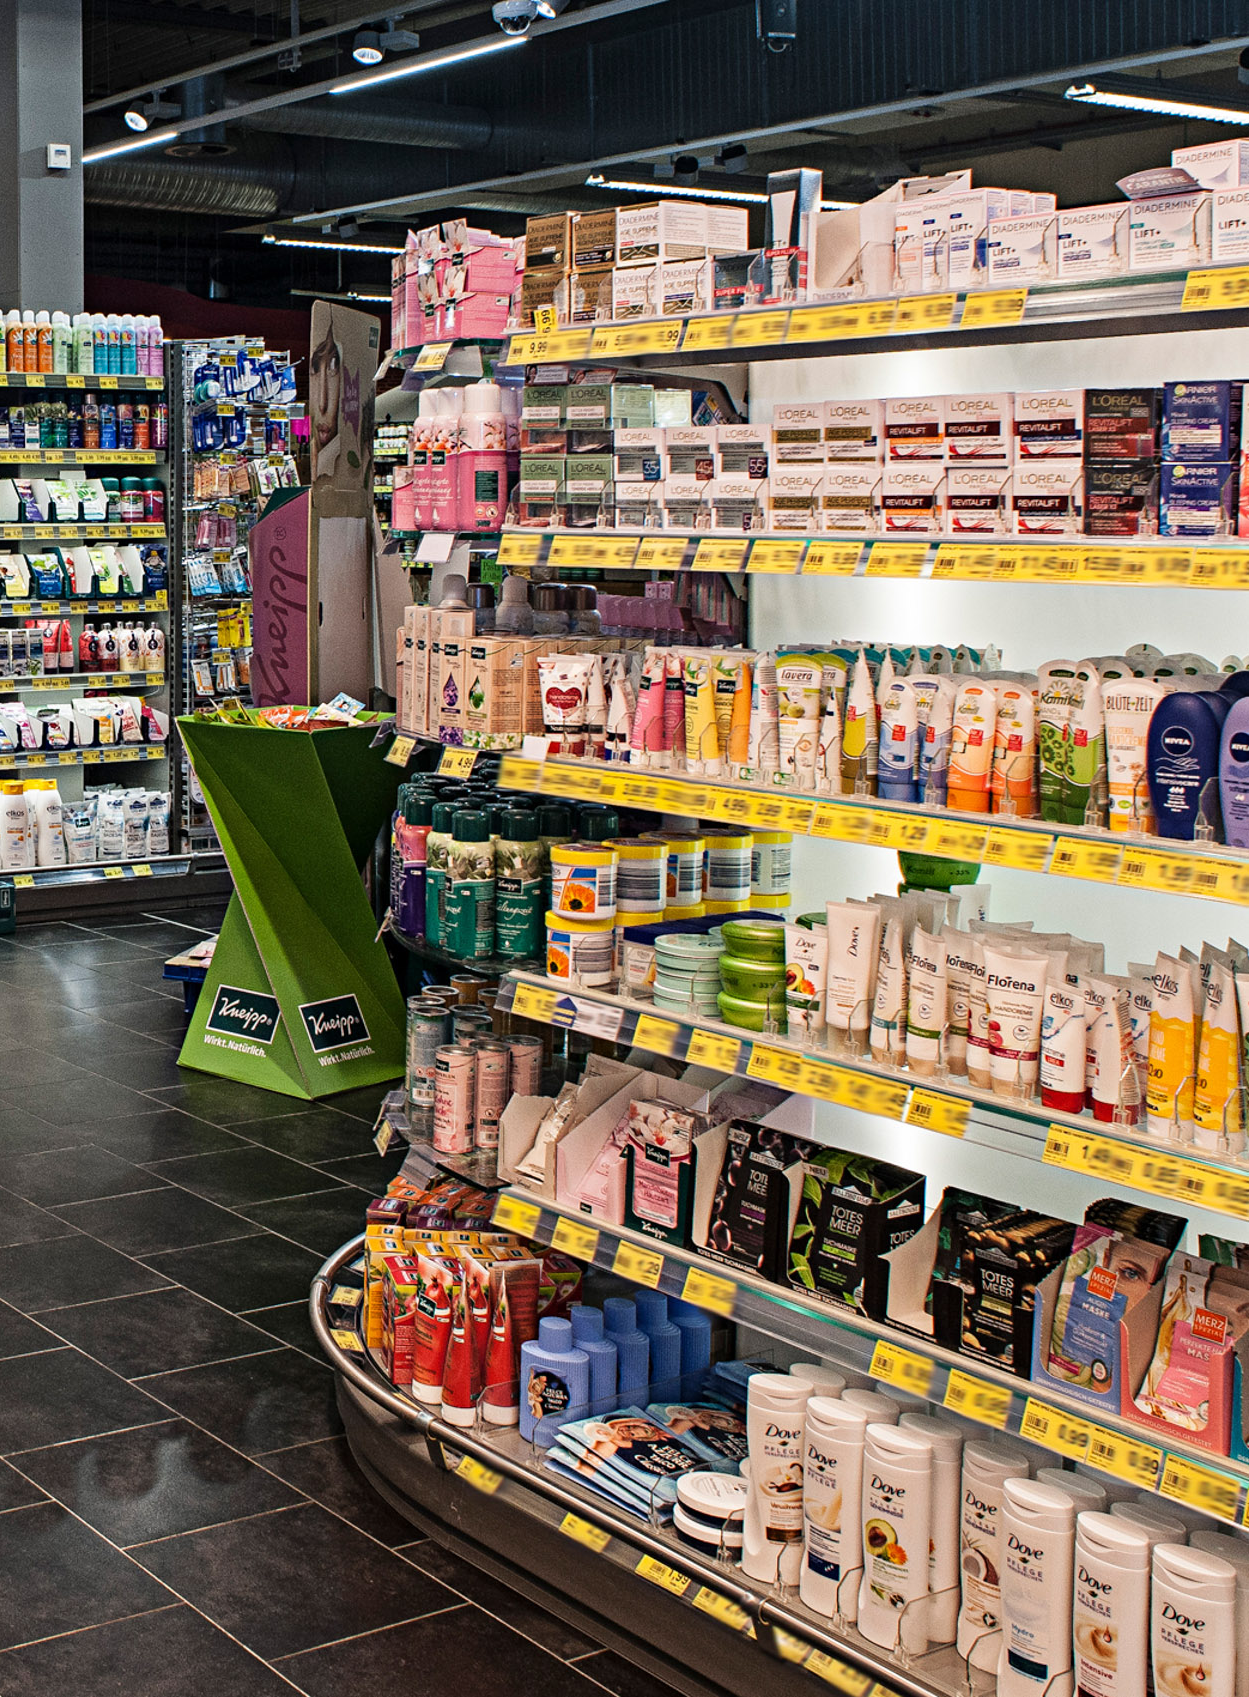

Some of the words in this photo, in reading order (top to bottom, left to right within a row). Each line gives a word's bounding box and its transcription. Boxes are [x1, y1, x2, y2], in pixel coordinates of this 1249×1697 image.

[1175, 147, 1233, 164] DIADERMINE
[1134, 199, 1197, 214] DIADERMINE
[619, 211, 659, 226] DIADERMINE
[1062, 210, 1121, 226] DIADERMINE
[1218, 219, 1246, 229] LIFT+
[950, 223, 974, 233] LIFT+
[992, 219, 1049, 234] DIADERMINE
[1134, 229, 1161, 239] LIFT+
[1062, 239, 1086, 248] LIFT+
[992, 247, 1016, 257] LIFT+
[892, 402, 936, 413] L'ORÉAL
[950, 399, 998, 411] L'ORÉAL
[1022, 397, 1073, 409] L'ORÉAL
[779, 408, 818, 420] L'ORÉAL
[889, 426, 926, 435] REVITALIFT
[949, 424, 987, 434] REVITALIFT
[1019, 422, 1062, 433] REVITALIFT
[749, 458, 768, 473] 55+
[888, 473, 933, 485] L'ORÉAL
[954, 472, 1001, 484] L'ORÉAL
[1020, 472, 1071, 484] L'ORÉAL
[886, 498, 923, 507] REVITALIFT
[952, 498, 991, 507] REVITALIFT
[1018, 499, 1059, 508] REVITALIFT
[253, 545, 307, 707] Kneipp
[780, 668, 813, 682] lavera
[1164, 737, 1191, 745] NIVEA
[796, 937, 816, 950] Dove
[988, 974, 1035, 992] Florena
[1153, 973, 1178, 993] elkos
[1050, 992, 1074, 1009] elkos
[218, 997, 268, 1031] Kneipp
[308, 1013, 355, 1037] Kneipp
[733, 1131, 750, 1142] NEU
[809, 1165, 827, 1177] NEU
[832, 1205, 863, 1223] TOTES
[642, 1220, 668, 1238] Kneipp
[830, 1217, 862, 1236] MEER
[980, 1268, 1015, 1288] TOTES
[1092, 1271, 1115, 1289] MERZ
[982, 1280, 1014, 1299] MEER
[1082, 1302, 1110, 1321] MASKE
[1195, 1314, 1225, 1330] MERZ
[765, 1423, 800, 1439] Dove
[1126, 1412, 1182, 1439] DERMATOLOGISCH
[1183, 1435, 1212, 1448] GETESTET
[764, 1445, 800, 1455] PFLEGE
[808, 1444, 837, 1467] Dove
[808, 1471, 836, 1489] PFLEGE
[870, 1474, 905, 1497] Dove
[965, 1489, 997, 1516] Dove
[1008, 1533, 1043, 1560] Dove
[1007, 1557, 1043, 1578] PFLEGE
[1078, 1565, 1112, 1595] Dove
[1077, 1590, 1111, 1613] PFLEGE
[1161, 1602, 1205, 1631] Dove
[1161, 1628, 1204, 1649] PFLEGE
[1081, 1659, 1113, 1680] Intensive
